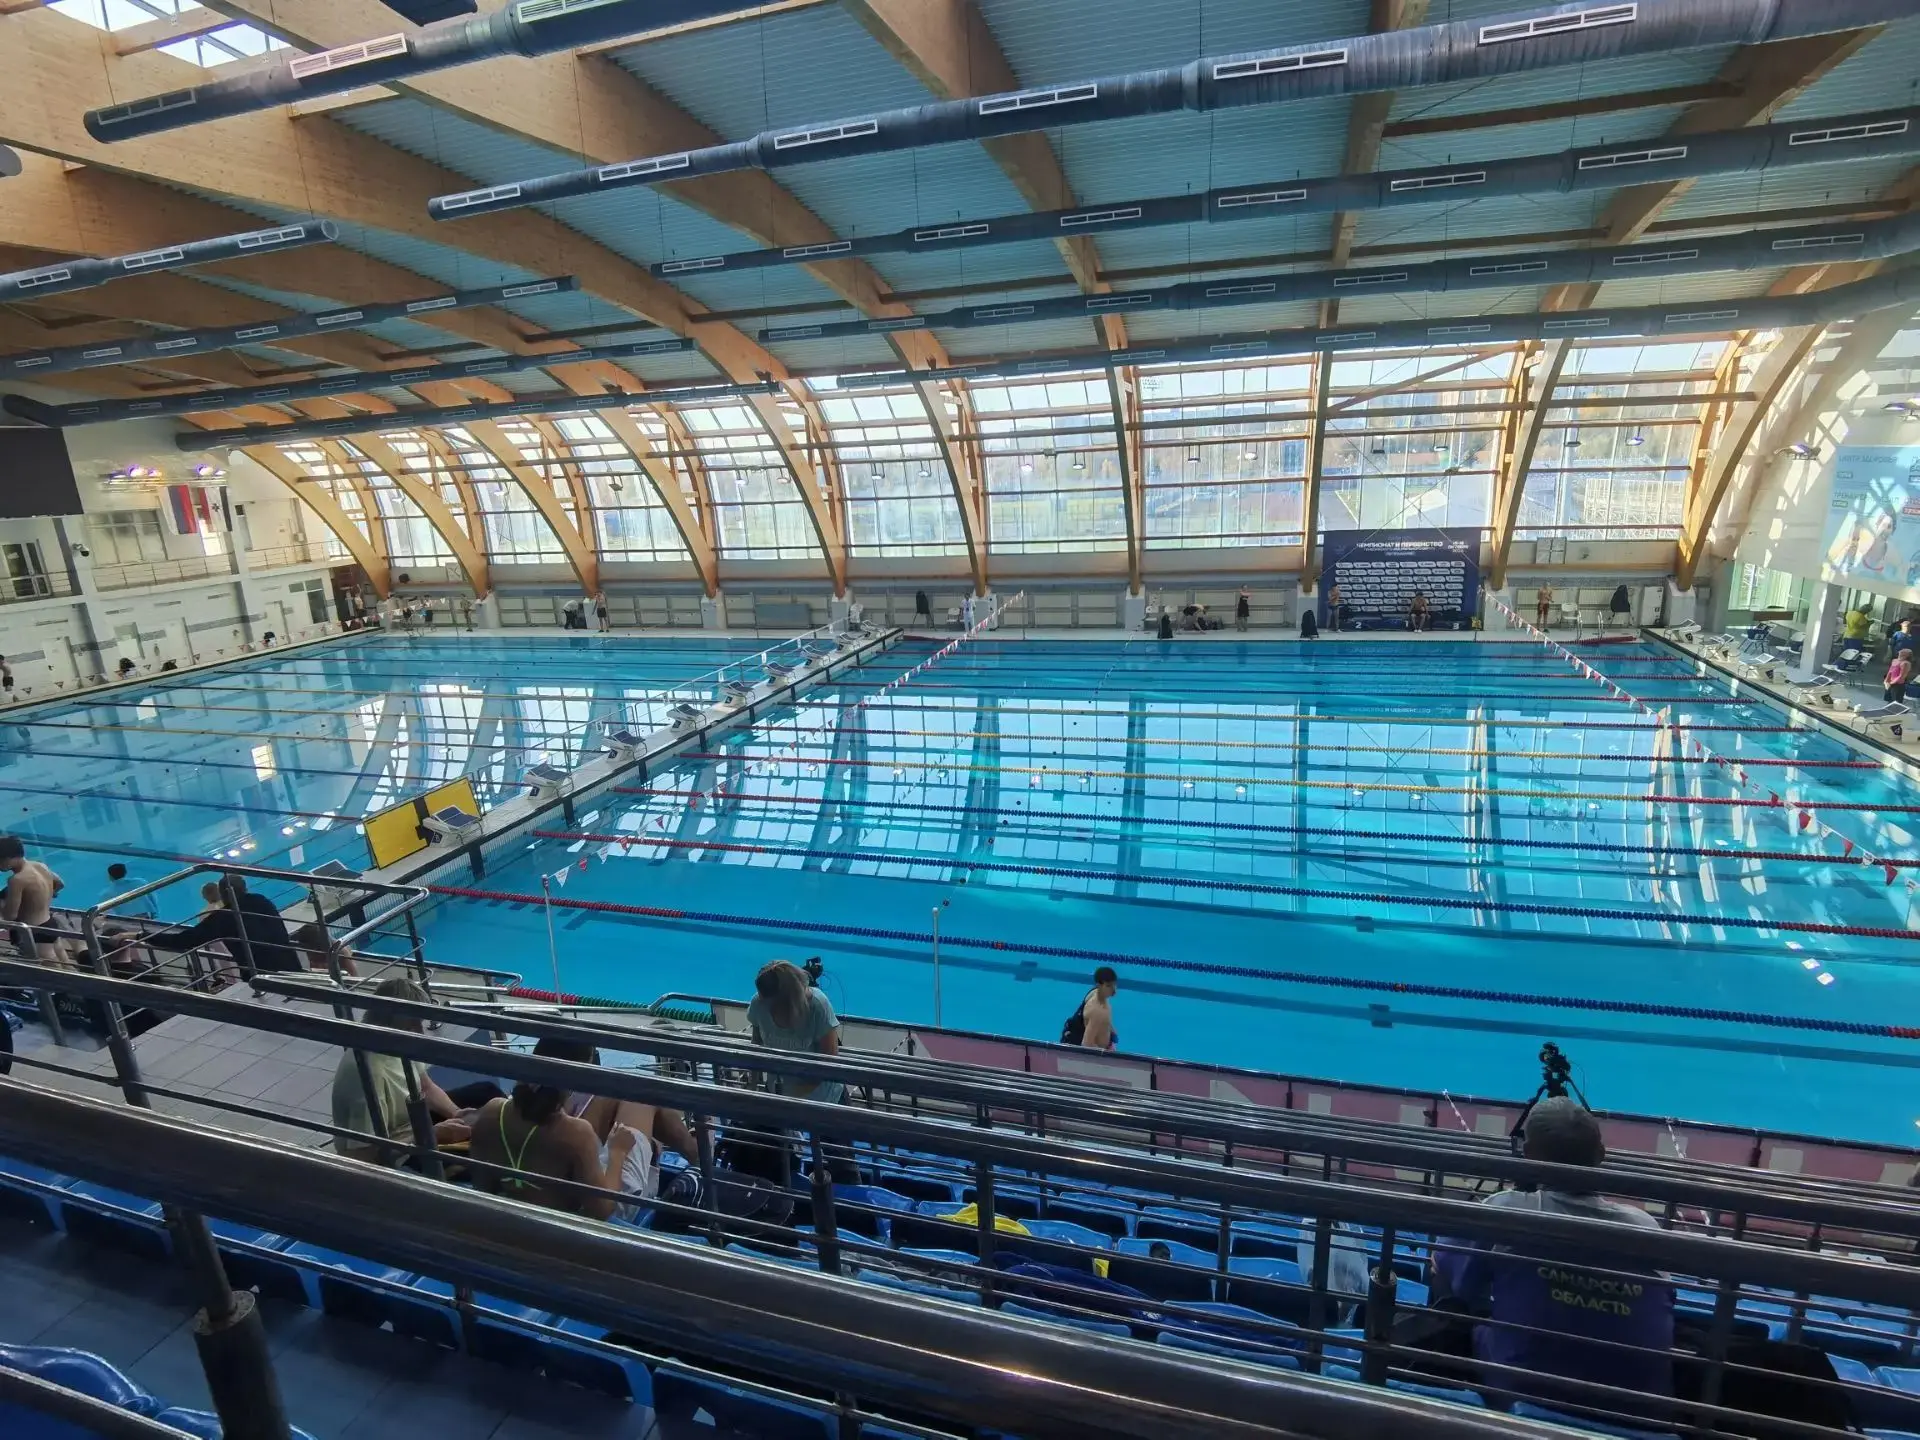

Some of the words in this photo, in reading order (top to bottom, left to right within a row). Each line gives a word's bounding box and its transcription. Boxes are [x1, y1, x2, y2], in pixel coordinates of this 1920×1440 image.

[1355, 621, 1362, 629] 2
[1453, 622, 1460, 630] 3
[1537, 1266, 1643, 1297] САМАРСКАЯ
[1551, 1288, 1632, 1315] ОБЛАСТЬ
